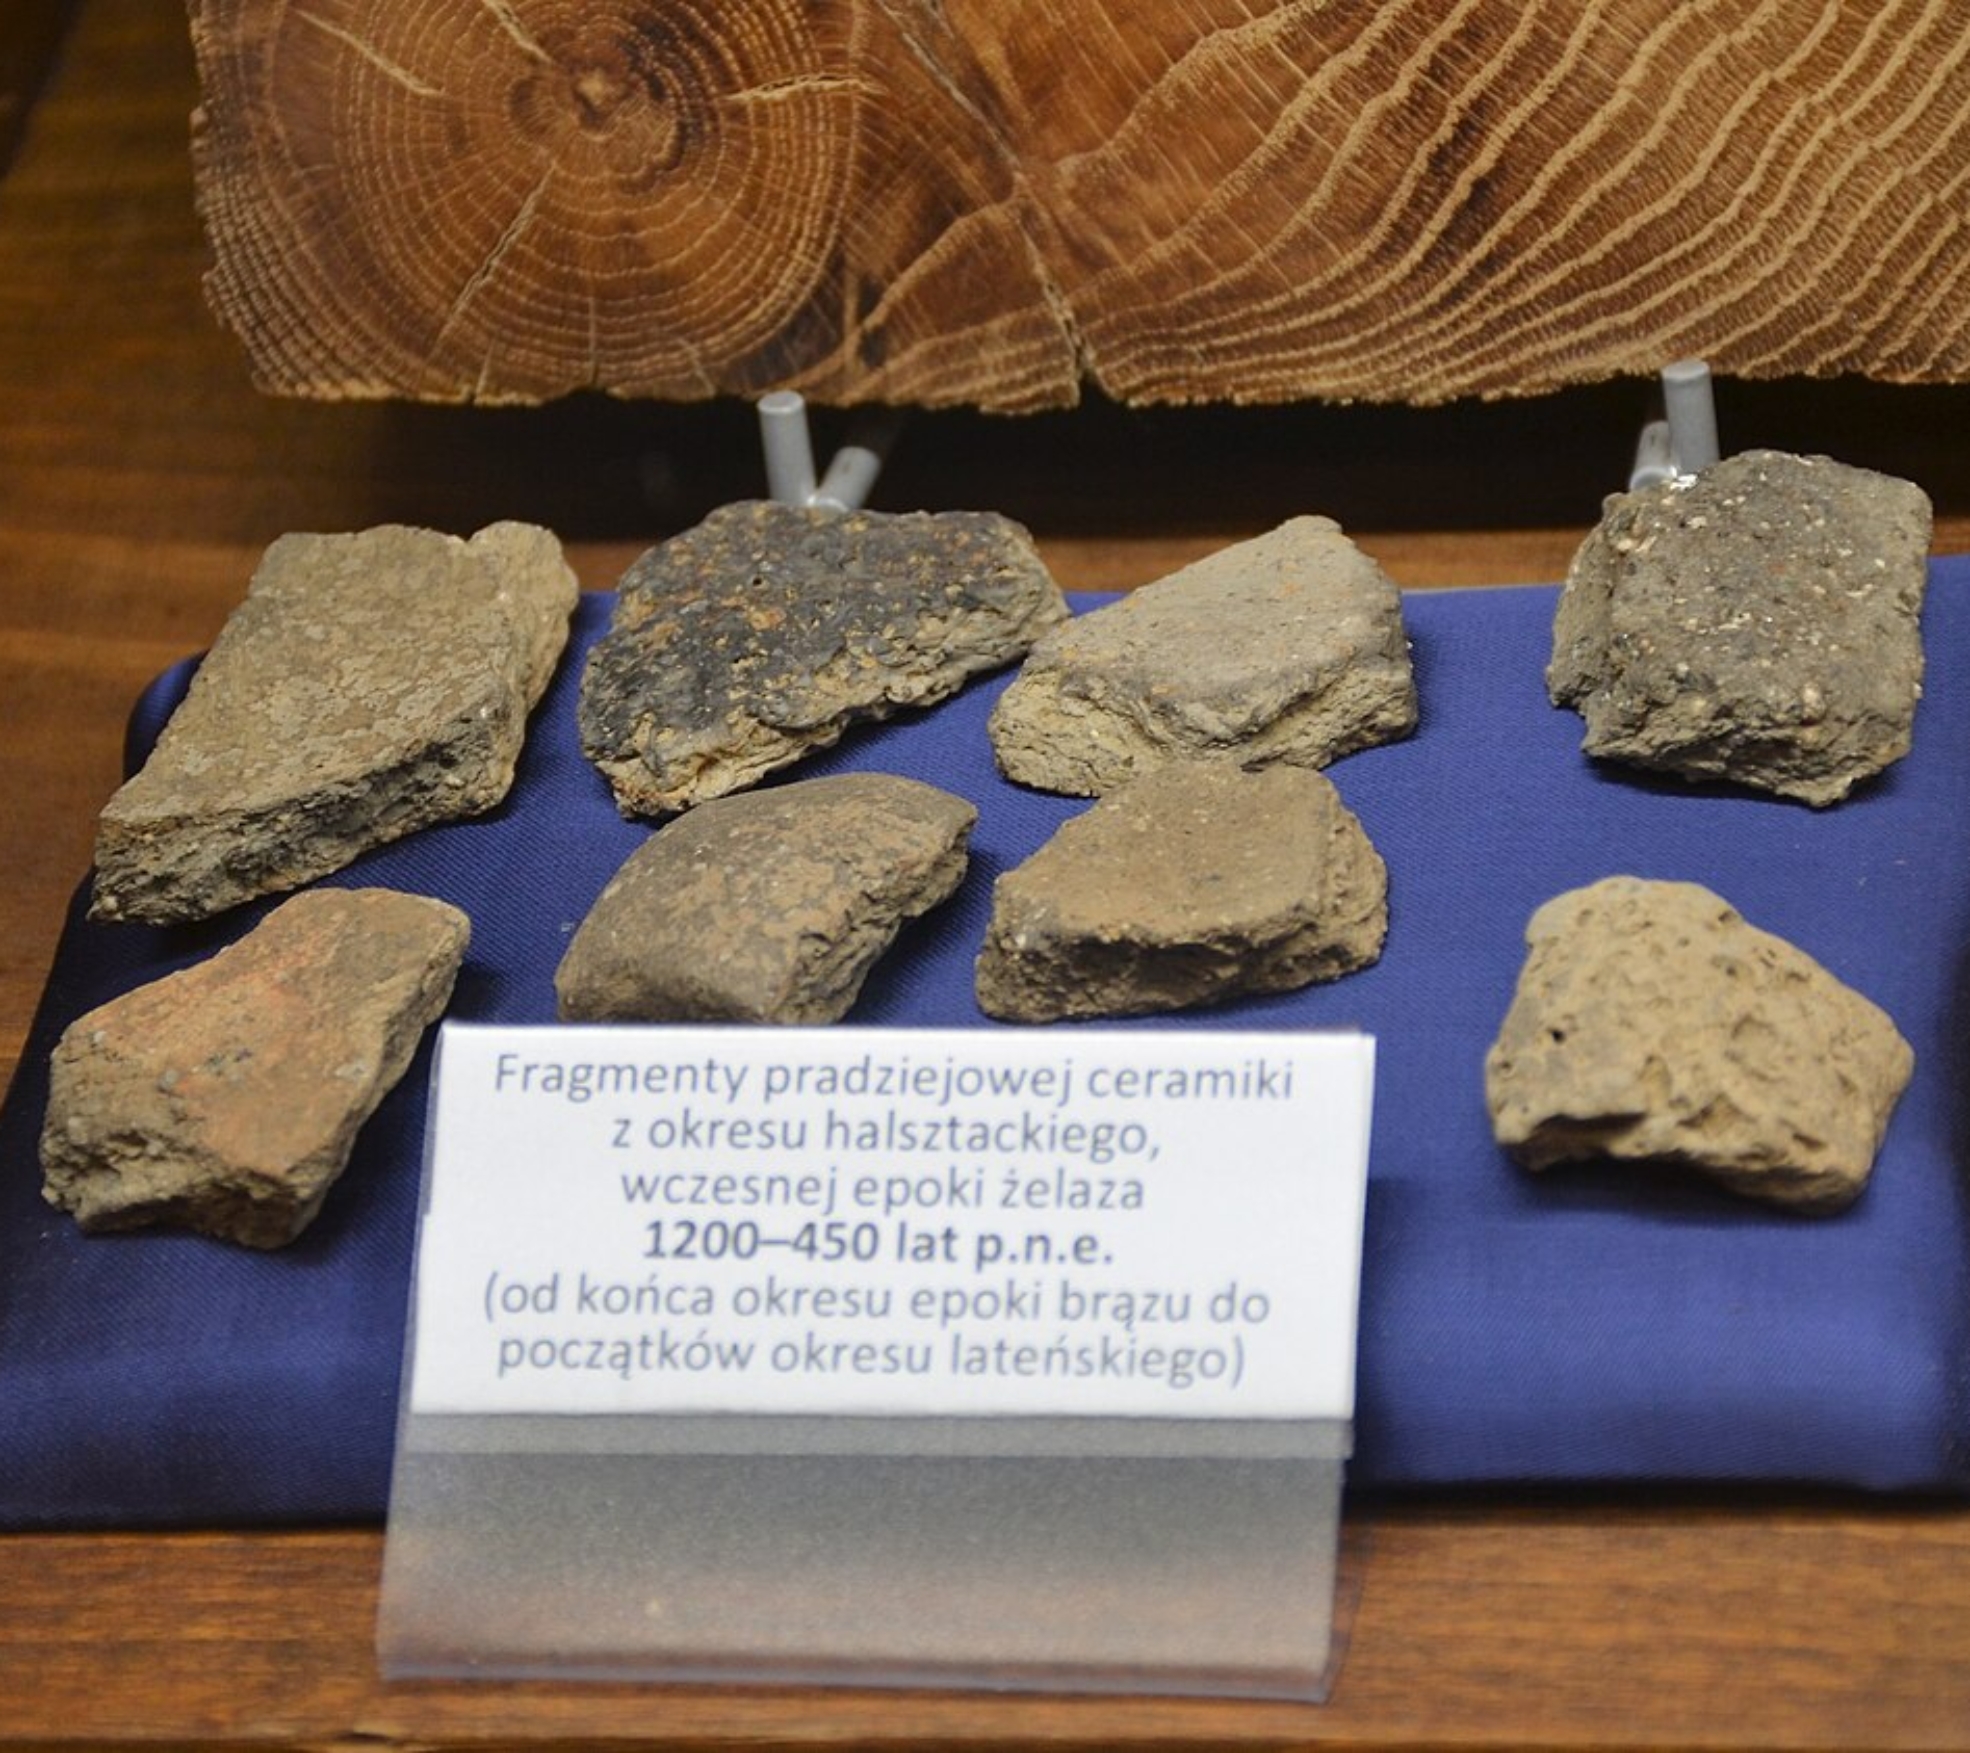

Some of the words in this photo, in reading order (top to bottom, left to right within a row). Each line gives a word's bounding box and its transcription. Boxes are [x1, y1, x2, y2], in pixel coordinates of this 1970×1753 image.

[495, 1053, 749, 1104] Fragmenty
[763, 1054, 1072, 1107] pradziejowej
[1087, 1059, 1293, 1098] ceramiki
[612, 1118, 632, 1149] z
[648, 1106, 807, 1151] okresu
[825, 1108, 1160, 1164] halsztackiego,
[621, 1166, 837, 1217] wczesnej
[853, 1165, 985, 1217] epoki
[1000, 1166, 1144, 1209] żelaza
[643, 1219, 880, 1262] 1200–450
[896, 1220, 959, 1263] lat
[974, 1232, 1114, 1274] p.n.e.
[484, 1271, 560, 1322] (od
[577, 1272, 715, 1316] końca
[732, 1275, 892, 1319] okresu
[910, 1280, 1041, 1327] epoki
[1059, 1280, 1191, 1332] brązu
[1209, 1281, 1270, 1323] do
[498, 1329, 755, 1380] początków
[771, 1330, 932, 1375] okresu
[951, 1333, 1244, 1389] lateńskiego)
